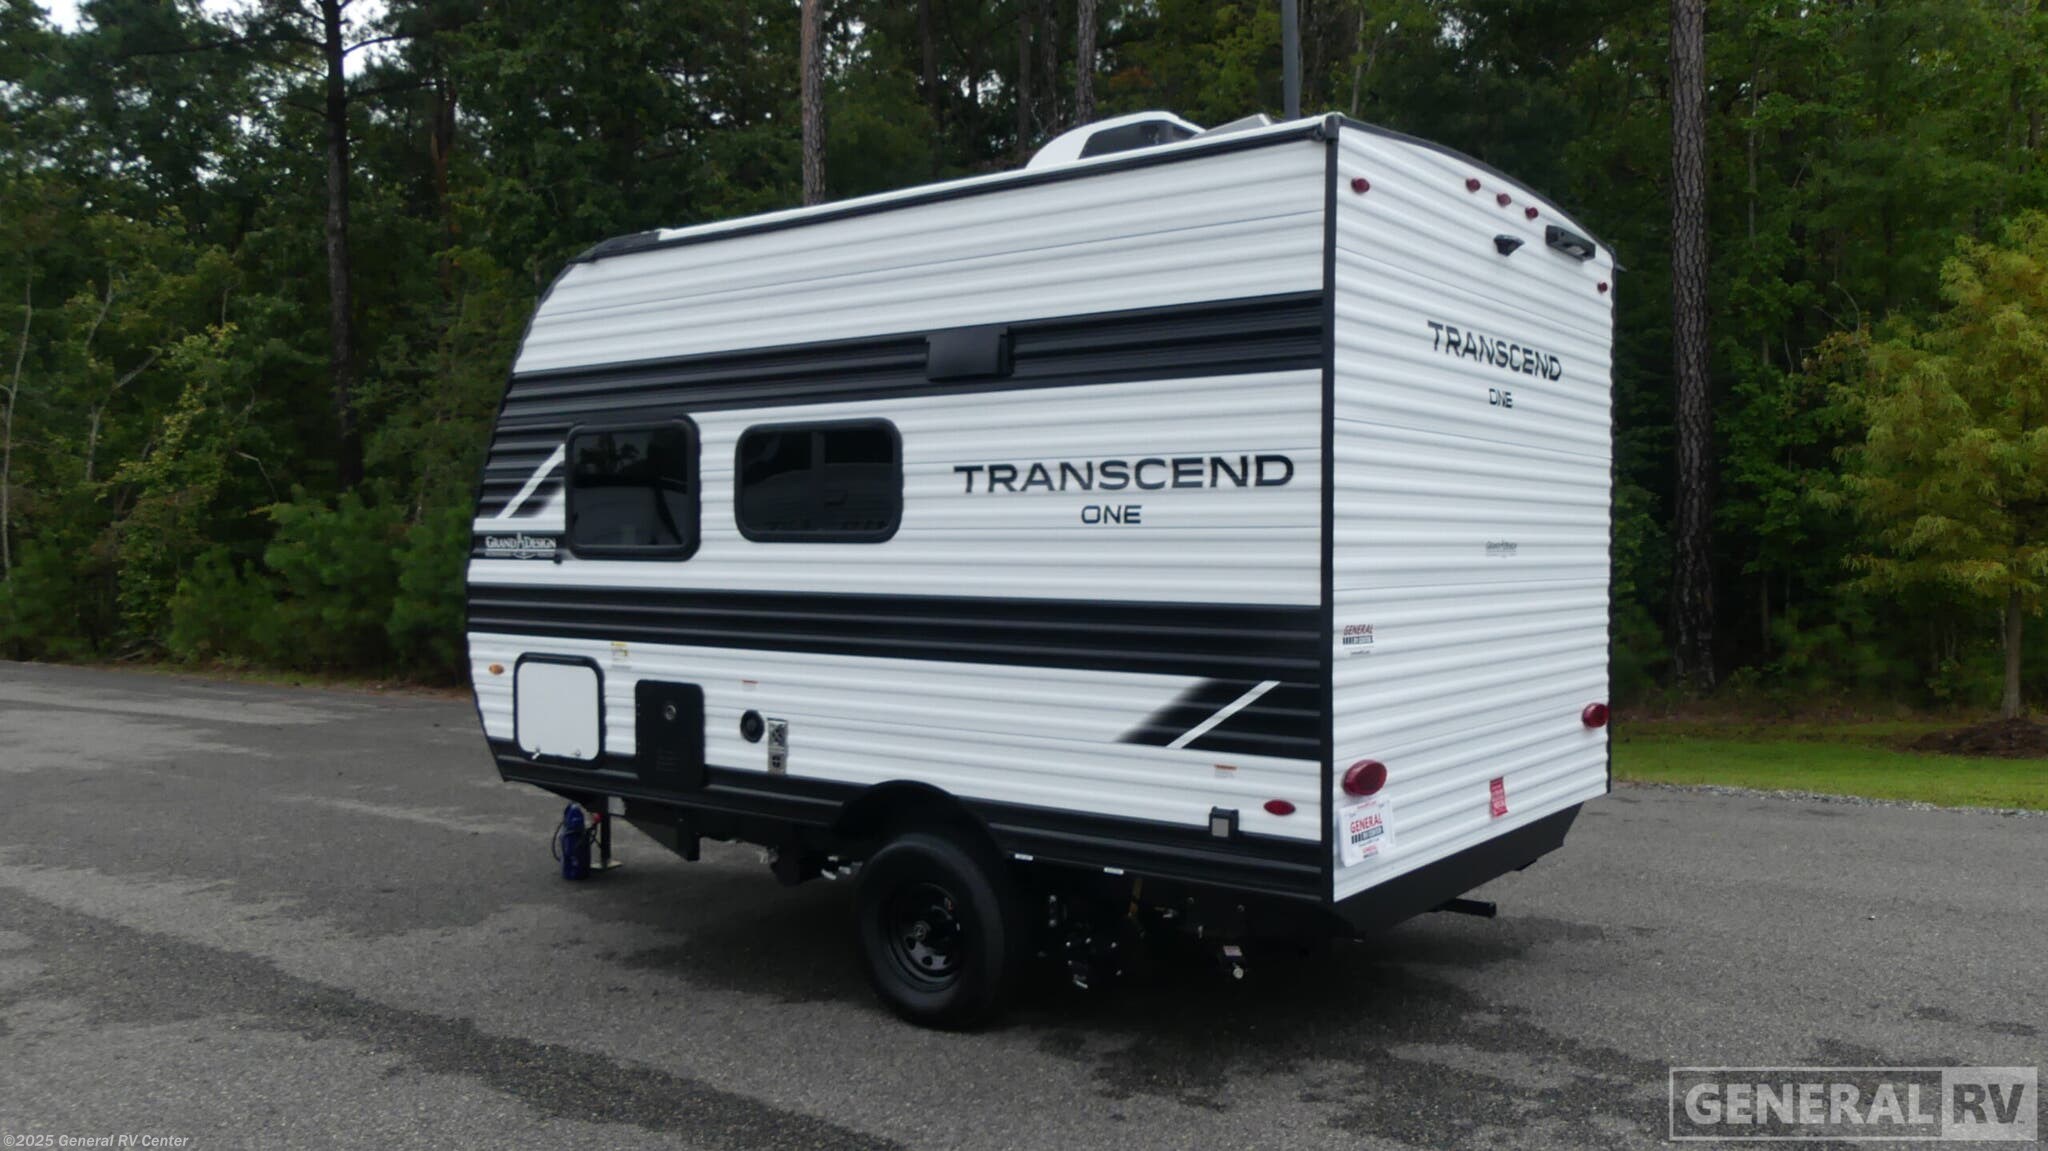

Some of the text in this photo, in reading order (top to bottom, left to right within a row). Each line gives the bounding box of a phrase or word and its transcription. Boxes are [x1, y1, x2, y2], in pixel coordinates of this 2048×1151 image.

[1427, 320, 1562, 381] TRANSCEND
[1489, 388, 1513, 408] ONE
[953, 455, 1294, 493] TRANSCEND
[1081, 505, 1142, 524] ONE
[1343, 624, 1374, 635] GENERAL
[1351, 813, 1382, 833] GENERAL
